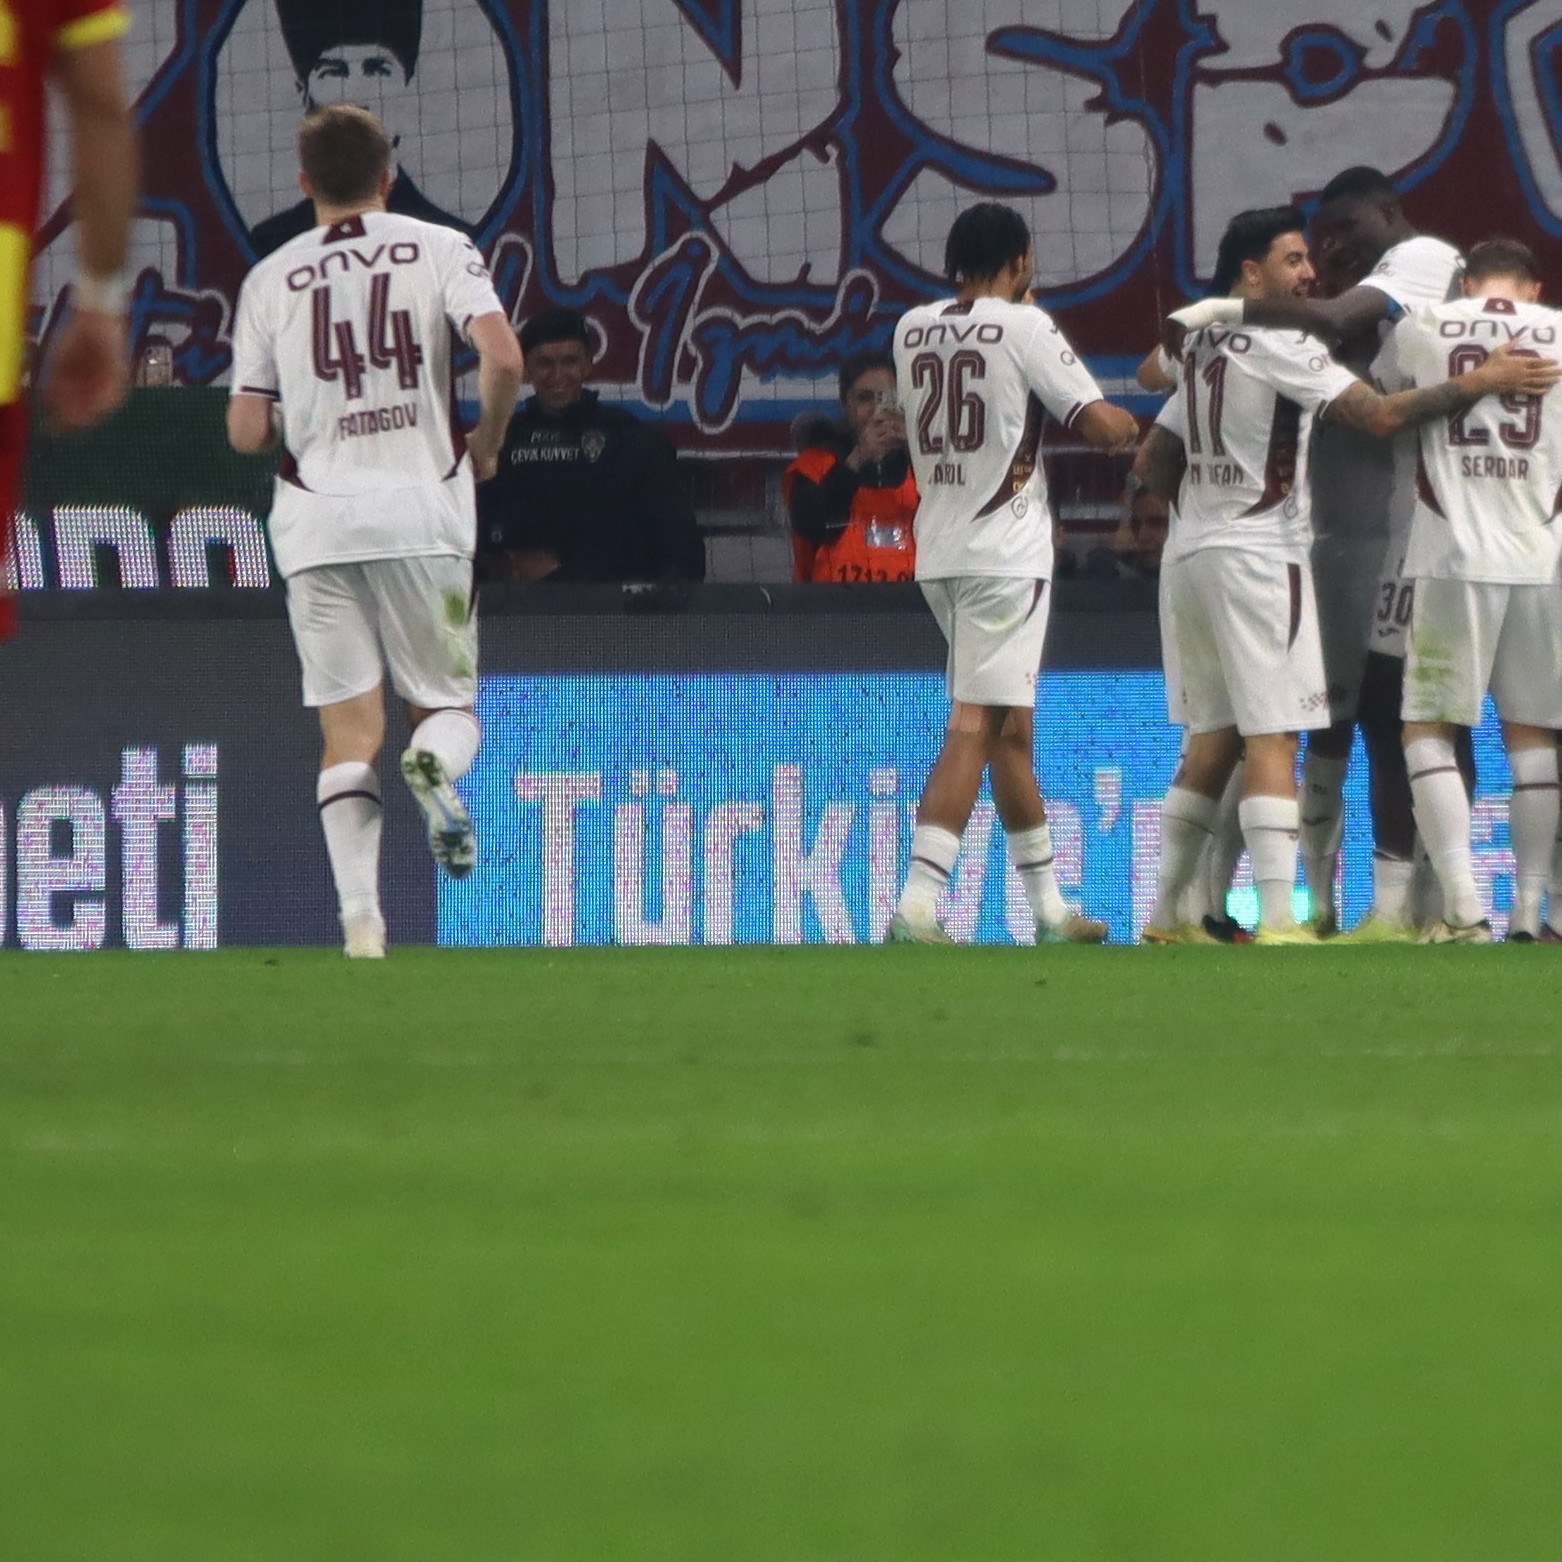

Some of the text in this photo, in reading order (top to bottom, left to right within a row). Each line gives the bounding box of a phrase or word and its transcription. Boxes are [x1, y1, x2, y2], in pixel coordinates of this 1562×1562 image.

[287, 242, 419, 292] onvo
[312, 272, 423, 400] 44
[903, 323, 1004, 349] onvo
[1439, 320, 1556, 344] onvo
[911, 350, 986, 456] 26
[1183, 351, 1229, 457] 11
[1461, 456, 1529, 481] SERDAR
[1378, 583, 1413, 623] 30
[515, 762, 1341, 946] Türkiye'
